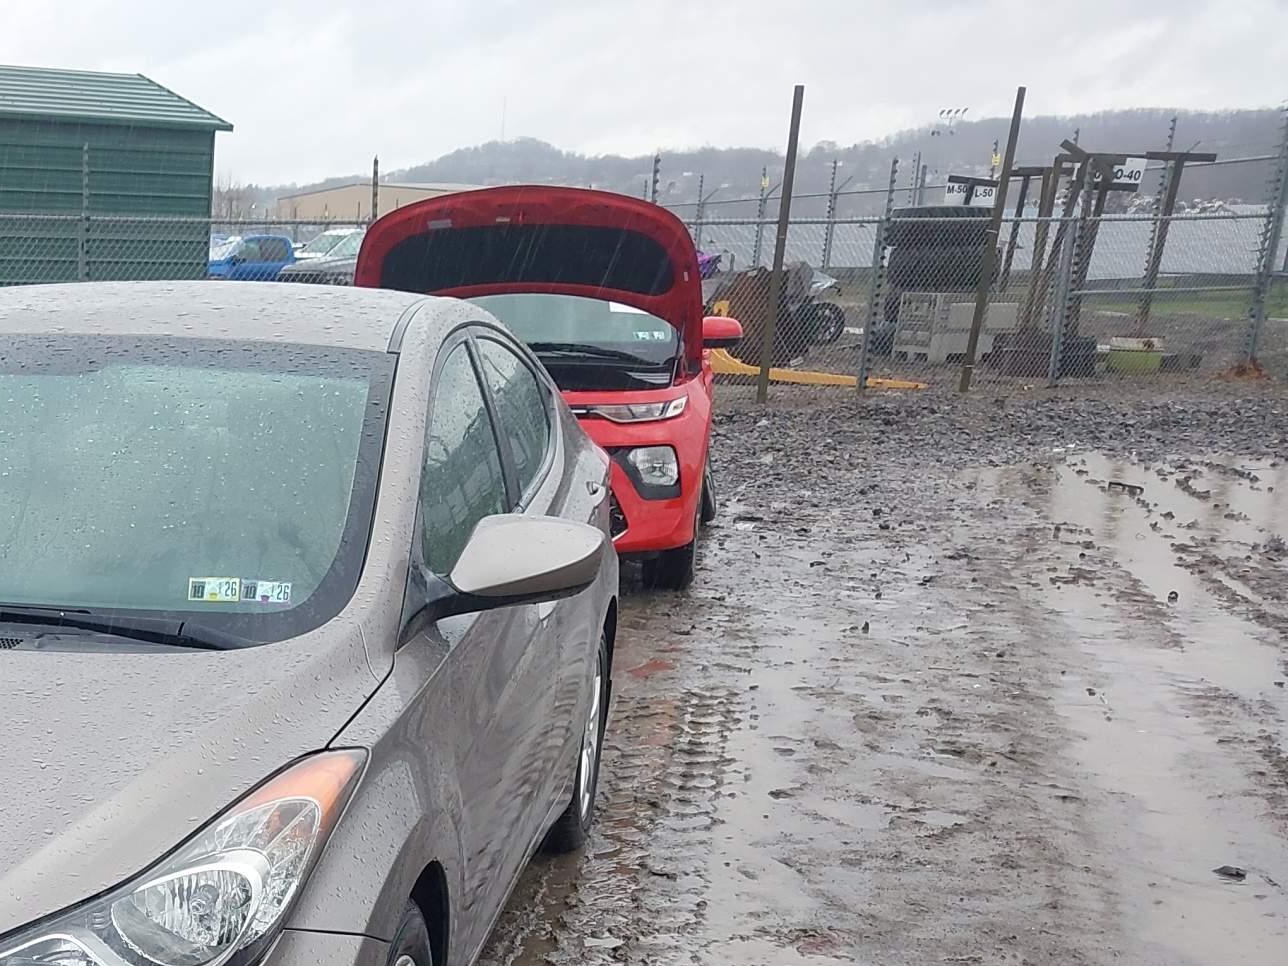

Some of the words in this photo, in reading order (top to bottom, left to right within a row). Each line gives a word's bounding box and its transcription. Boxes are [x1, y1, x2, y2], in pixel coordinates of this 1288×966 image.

[946, 183, 968, 195] M-50
[974, 187, 994, 198] L-50
[224, 581, 237, 597] 26
[276, 584, 290, 601] 26
